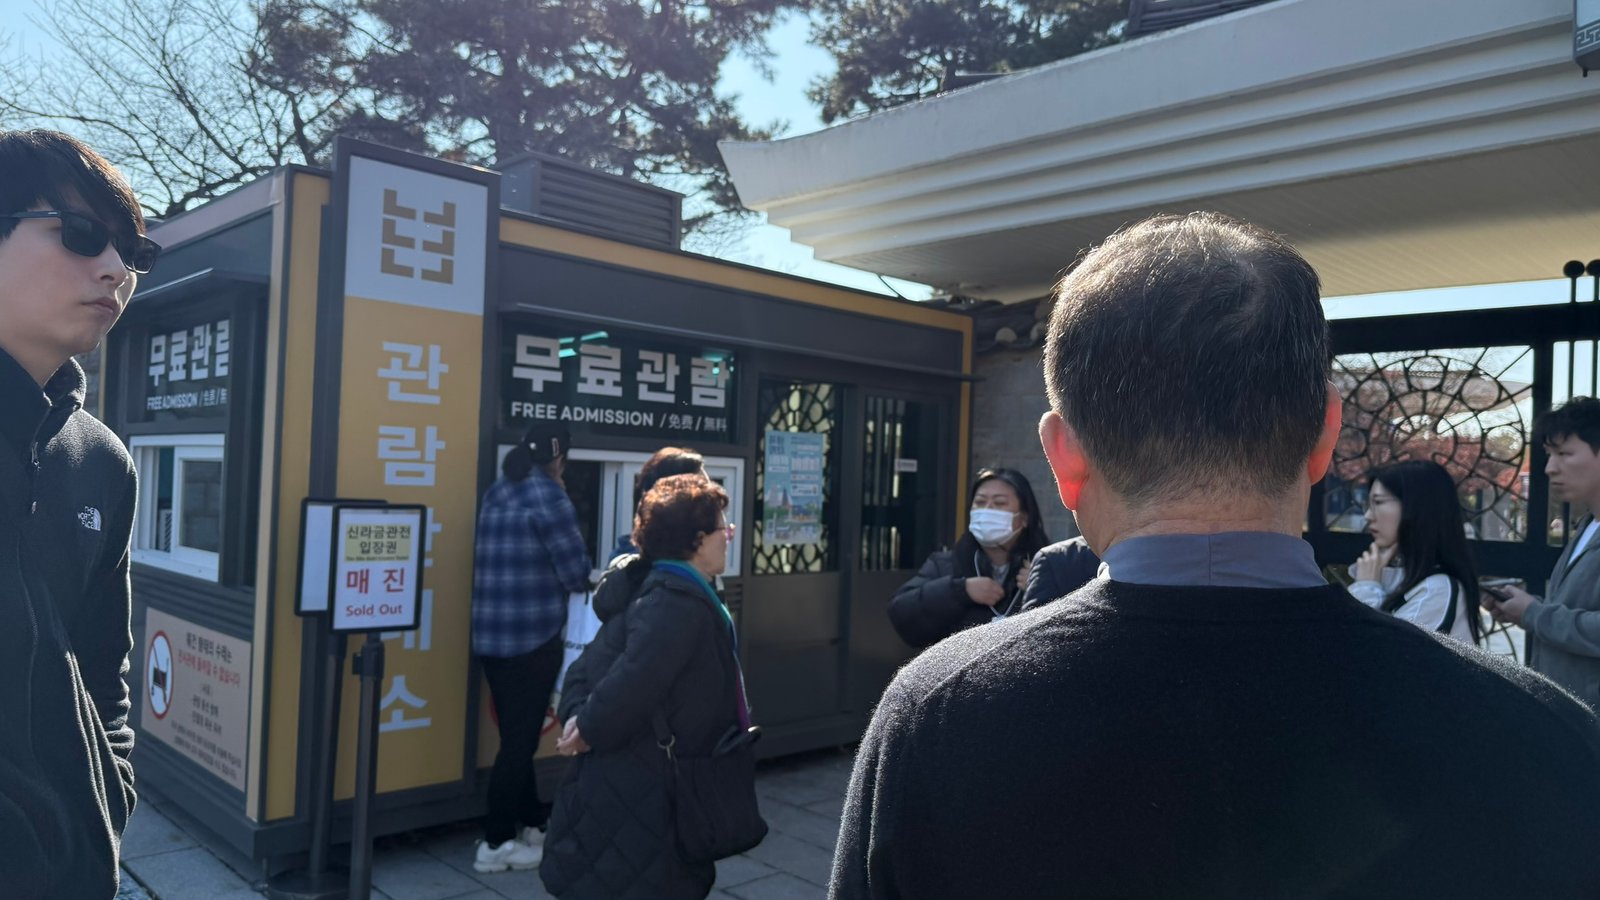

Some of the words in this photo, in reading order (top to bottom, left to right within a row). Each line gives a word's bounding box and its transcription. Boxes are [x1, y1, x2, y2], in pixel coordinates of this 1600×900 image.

[512, 333, 729, 408] 무료관람
[511, 401, 557, 420] FREE
[560, 405, 654, 426] ADMISSION
[347, 525, 411, 539] 신라금관전
[360, 541, 397, 554] 입장권
[346, 604, 375, 617] Sold
[379, 603, 402, 615] Out
